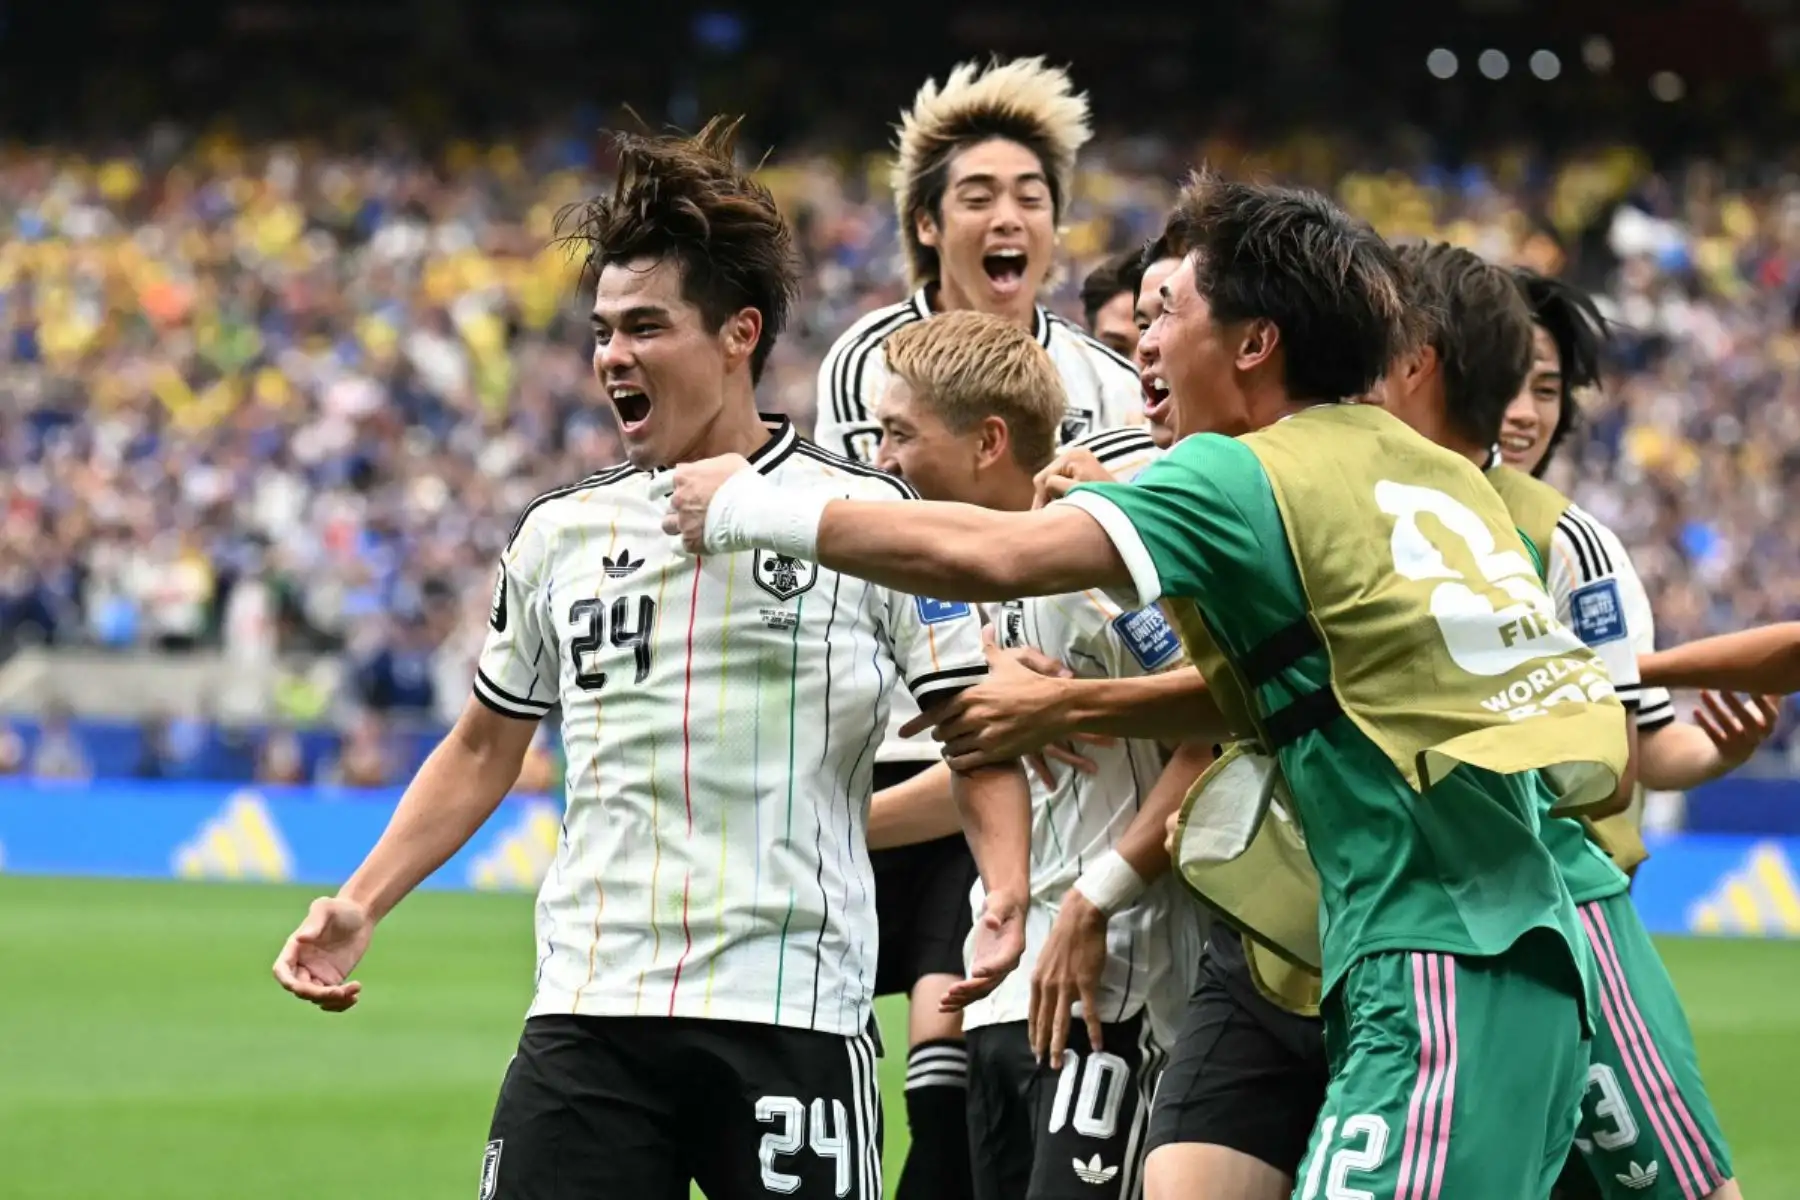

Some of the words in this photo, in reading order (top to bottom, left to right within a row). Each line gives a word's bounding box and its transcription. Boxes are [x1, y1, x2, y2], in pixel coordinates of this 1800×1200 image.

[569, 595, 656, 690] 24
[1049, 1049, 1130, 1139] 10
[1574, 1063, 1640, 1155] 3
[755, 1096, 851, 1198] 24
[1301, 1113, 1390, 1200] 12
